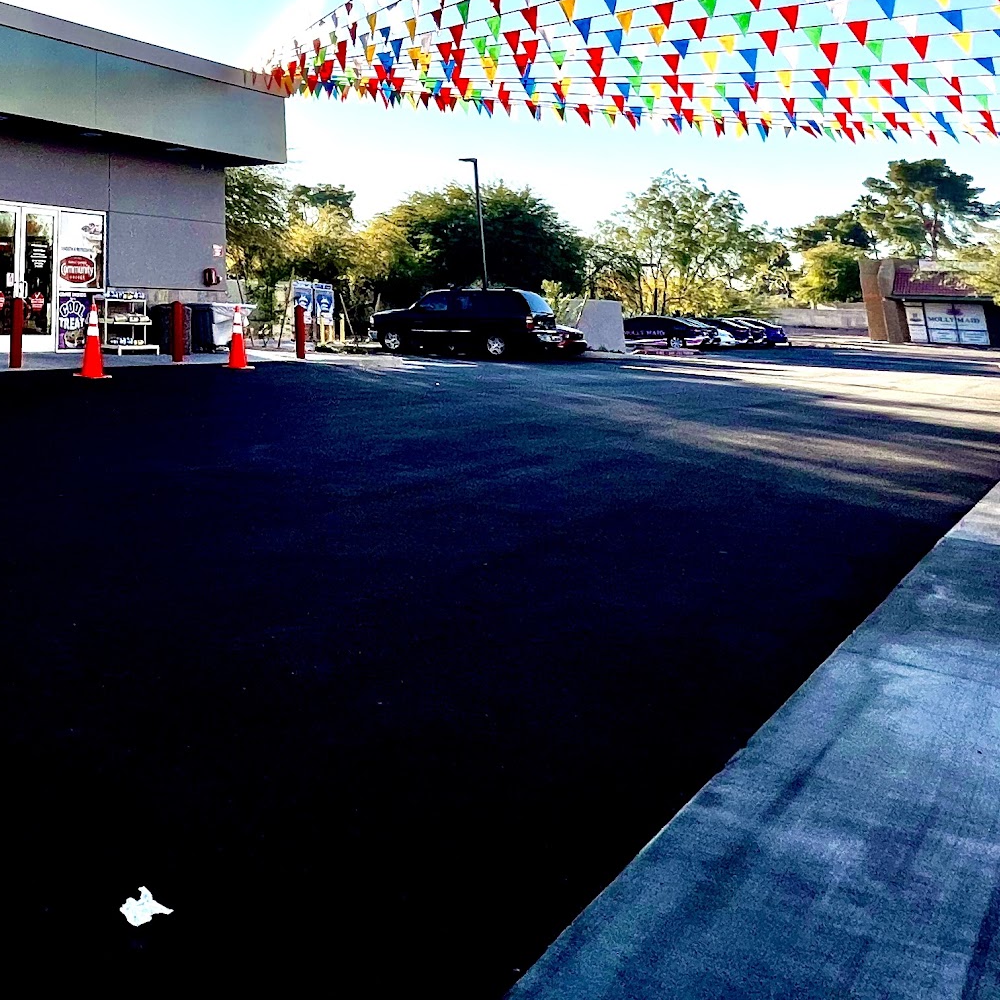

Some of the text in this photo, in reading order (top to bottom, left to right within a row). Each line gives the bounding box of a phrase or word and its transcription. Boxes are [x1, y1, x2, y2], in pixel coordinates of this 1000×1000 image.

[60, 262, 94, 278] Community
[60, 301, 85, 317] COOL
[58, 317, 85, 330] TREAT
